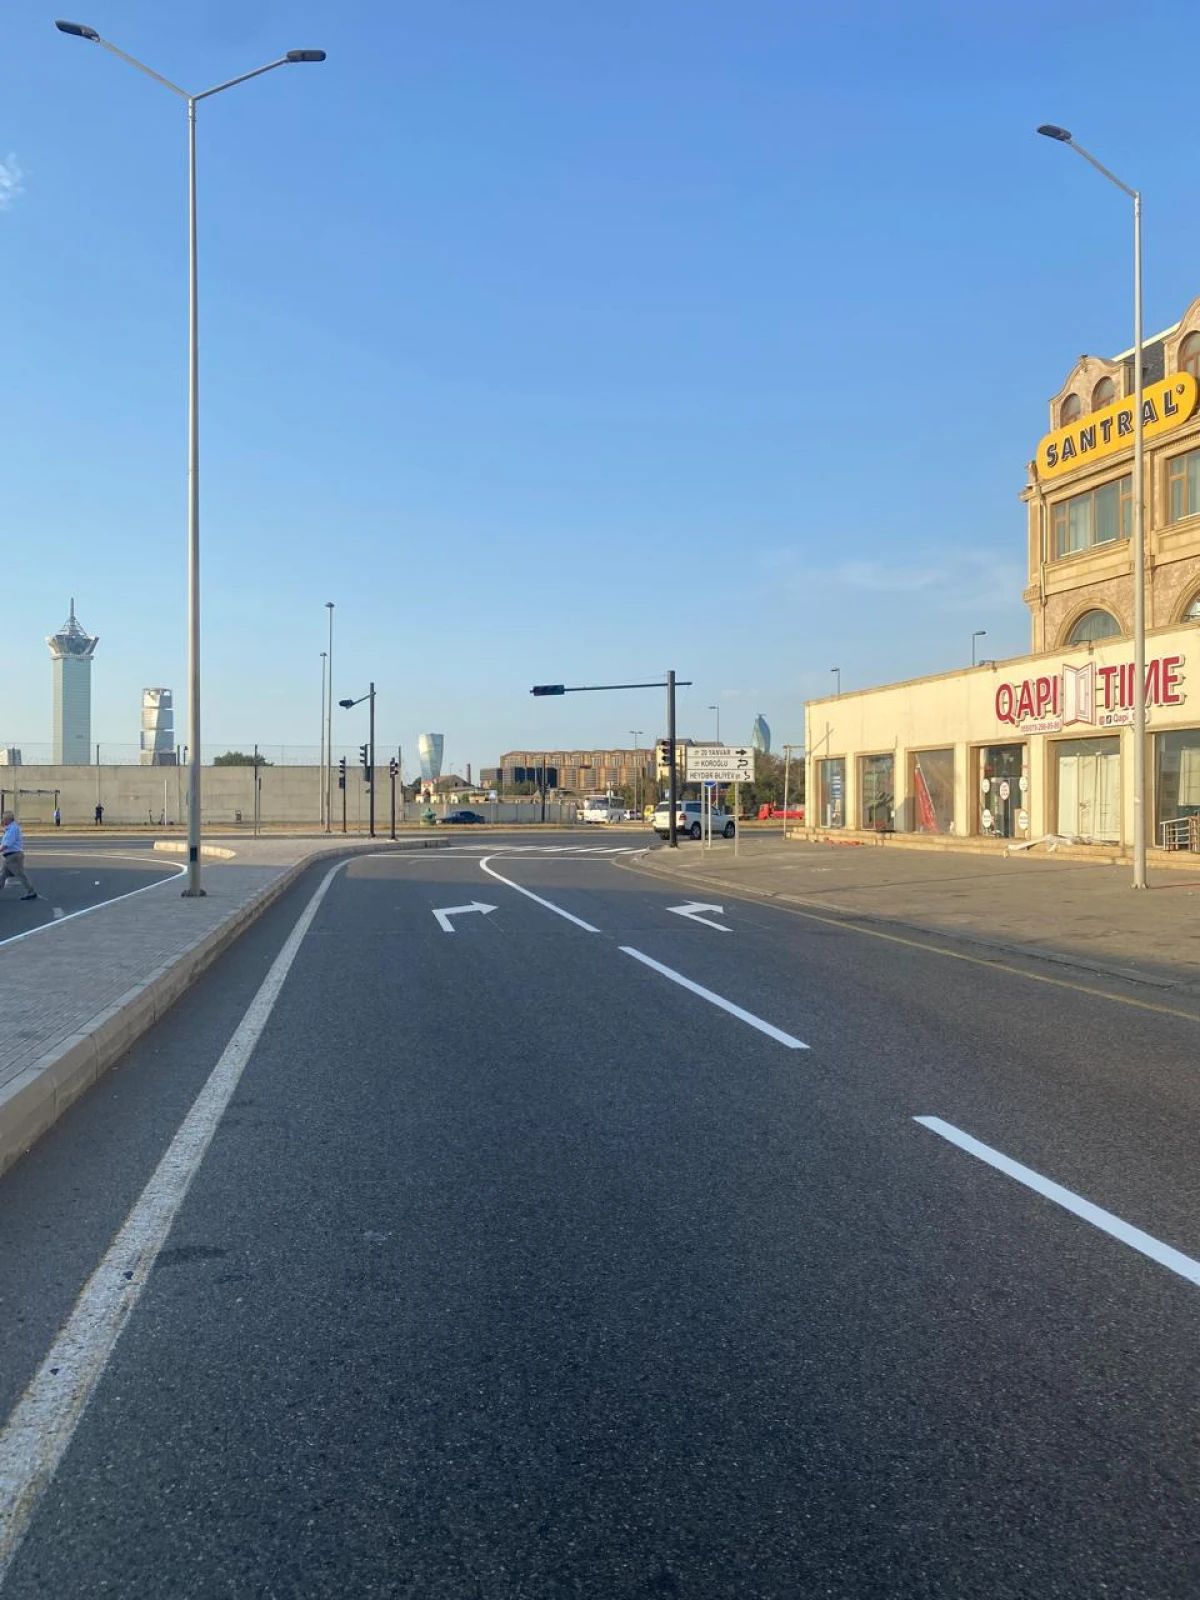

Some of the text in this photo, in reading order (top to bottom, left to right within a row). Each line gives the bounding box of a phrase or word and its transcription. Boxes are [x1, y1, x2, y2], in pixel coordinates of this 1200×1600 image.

[1046, 389, 1177, 467] SANTRAL
[995, 655, 1182, 725] QAPI TIME
